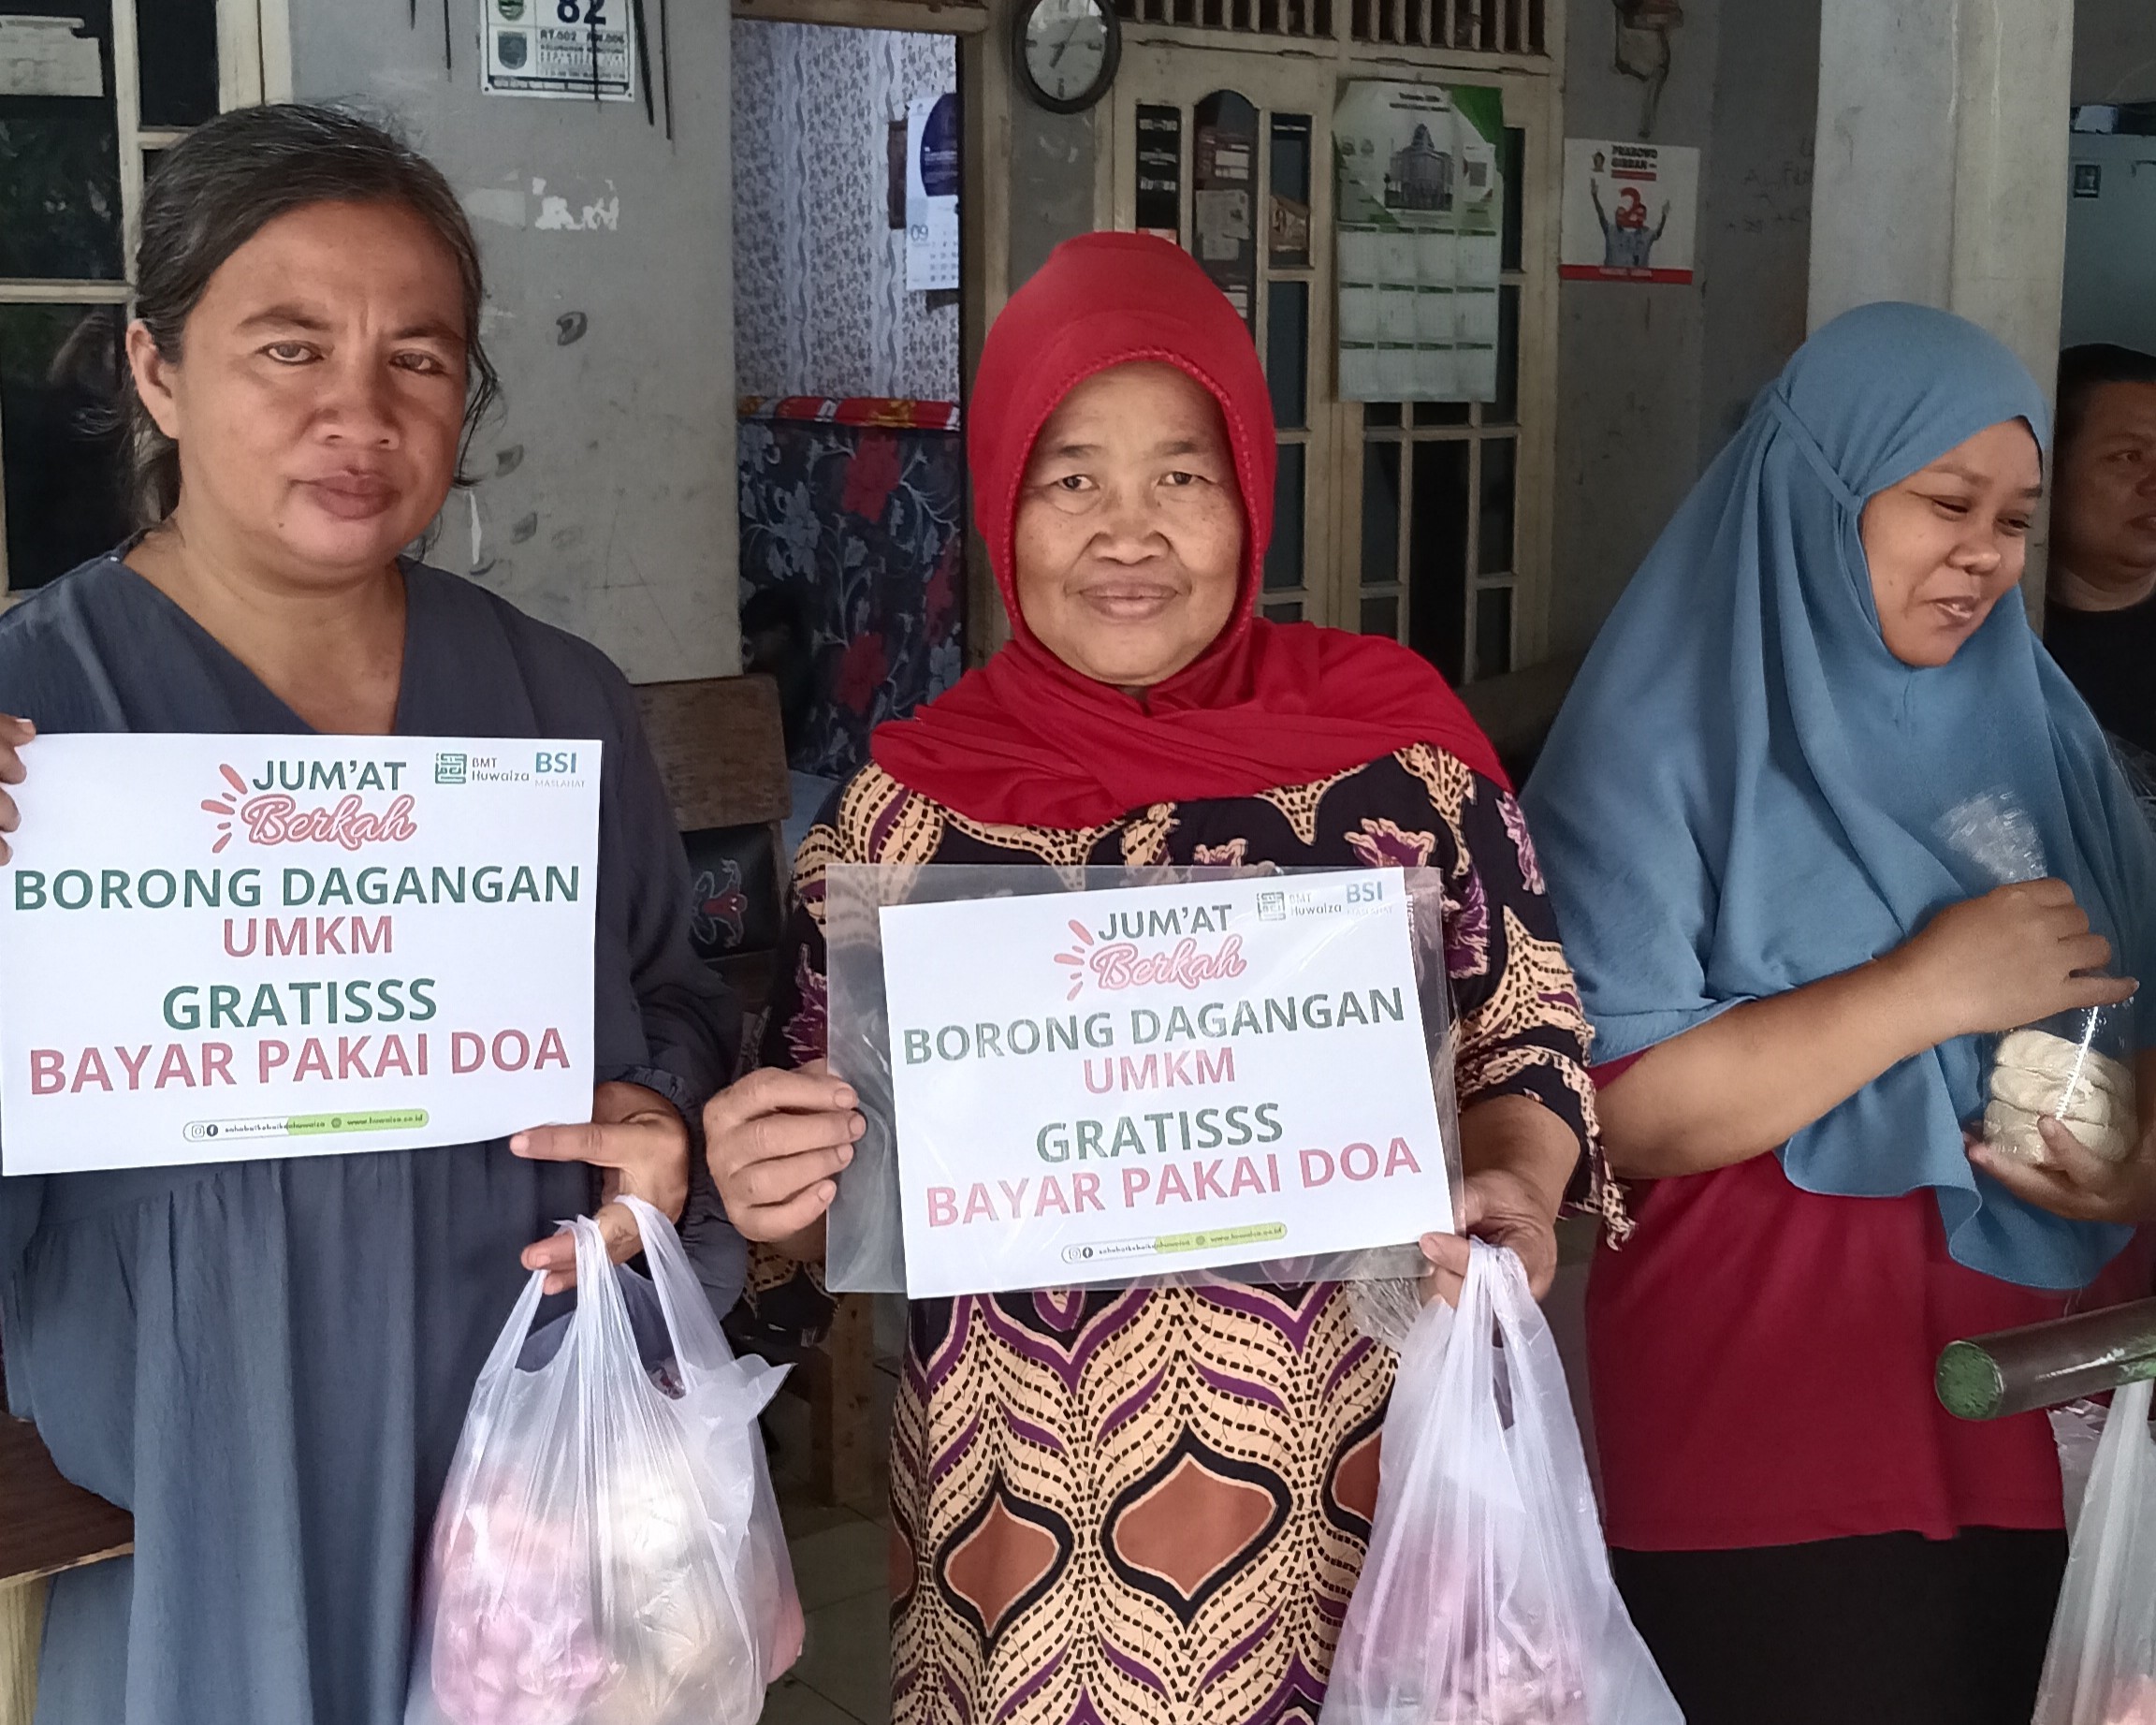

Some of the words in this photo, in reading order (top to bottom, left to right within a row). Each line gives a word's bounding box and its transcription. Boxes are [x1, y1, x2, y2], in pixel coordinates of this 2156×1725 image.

[252, 759, 407, 791] JUM'AT
[472, 756, 498, 768] BMT
[535, 752, 577, 774] BSI
[240, 794, 417, 851] Berkah
[14, 868, 261, 911] BORONG
[283, 865, 579, 907] DAGANGAN
[1346, 881, 1383, 904] BSI
[224, 915, 393, 958] UMKM
[1098, 904, 1232, 942] JUM'AT
[1088, 934, 1247, 990] Berkah
[163, 977, 437, 1031] GRATISSS
[903, 1013, 1114, 1065] BORONG
[1131, 987, 1405, 1045] DAGANGAN
[30, 1042, 238, 1095] BAYAR
[258, 1033, 429, 1084] PAKAI
[452, 1028, 571, 1074] DOA
[1084, 1046, 1235, 1094] UMKM
[1036, 1103, 1283, 1162] GRATISSS
[926, 1172, 1106, 1228] BAYAR
[1123, 1152, 1280, 1208] PAKAI
[1299, 1136, 1422, 1189] DOA
